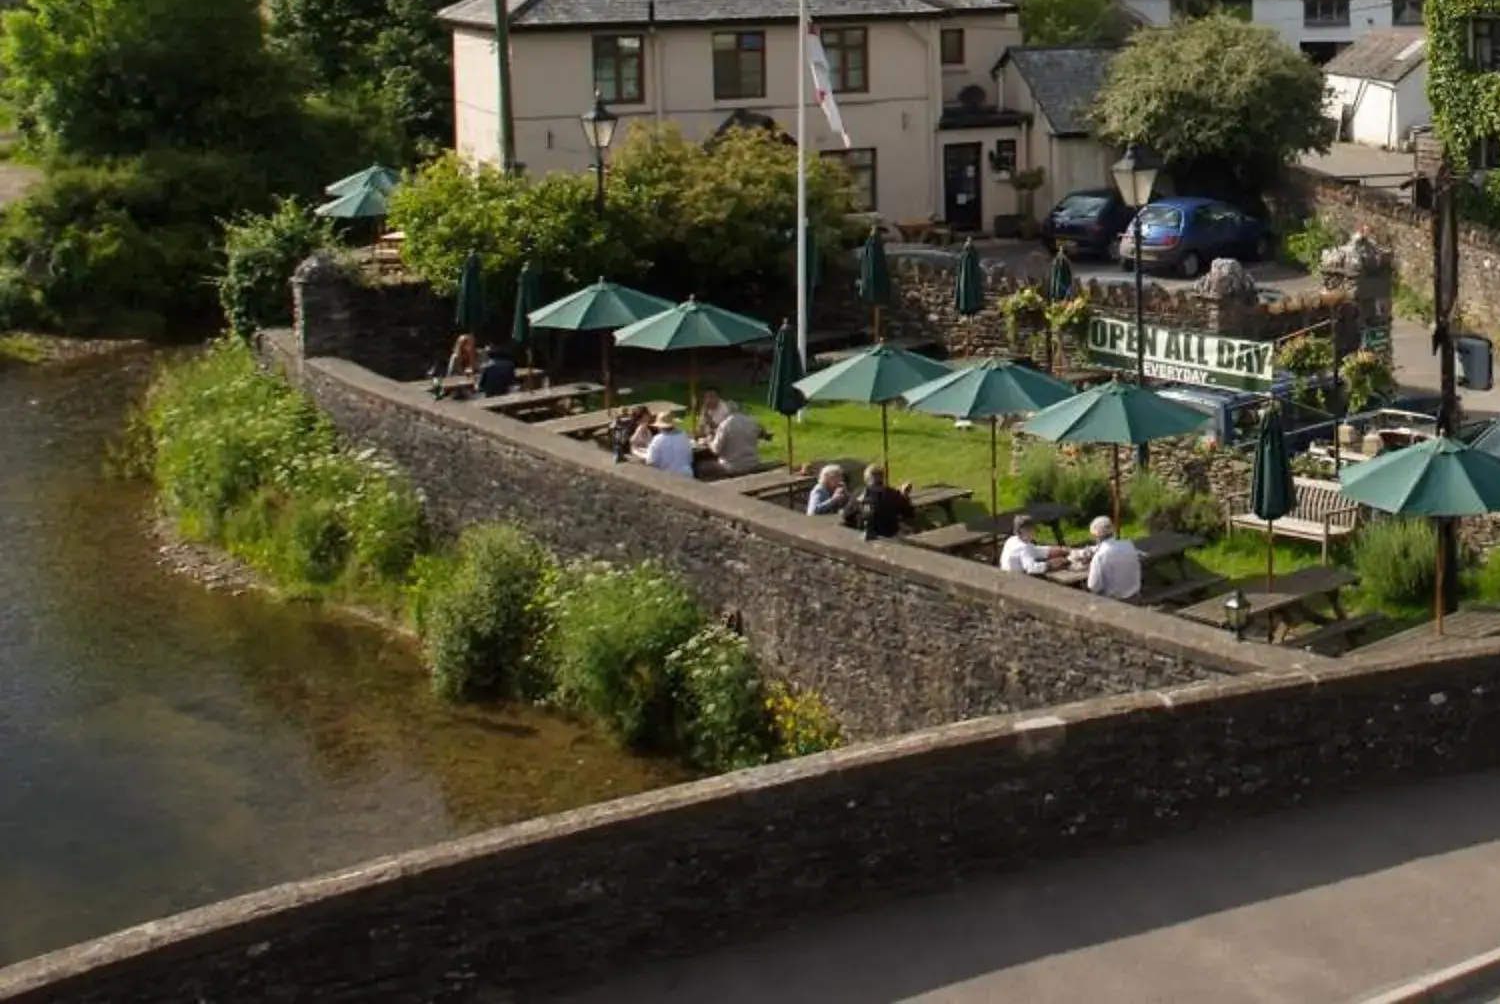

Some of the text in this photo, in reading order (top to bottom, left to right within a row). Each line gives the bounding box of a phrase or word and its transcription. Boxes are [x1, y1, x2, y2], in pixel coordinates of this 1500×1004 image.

[1091, 320, 1271, 375] OPEN ALL DAY
[1143, 361, 1208, 385] EVERYDAY
